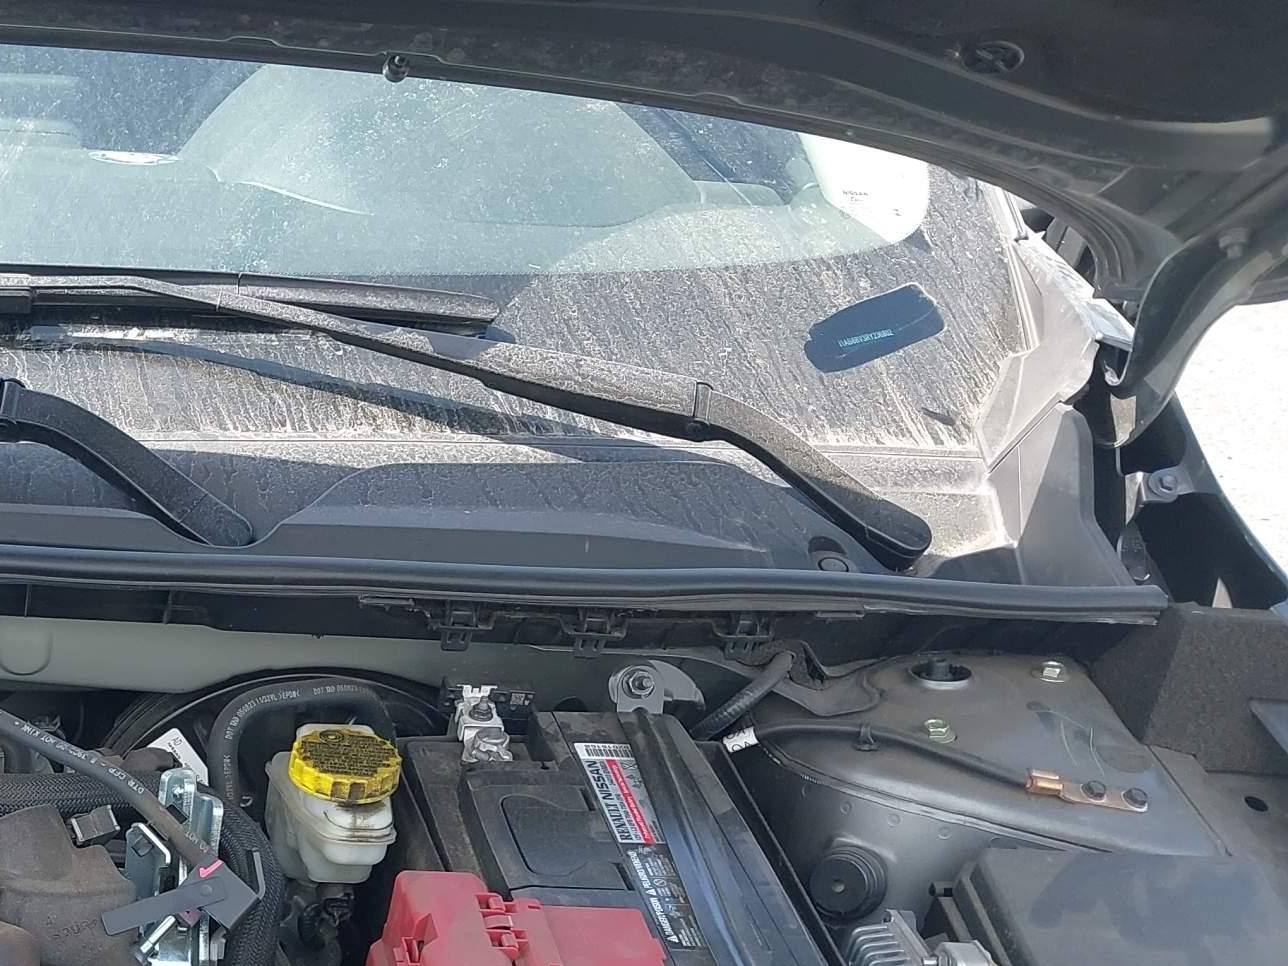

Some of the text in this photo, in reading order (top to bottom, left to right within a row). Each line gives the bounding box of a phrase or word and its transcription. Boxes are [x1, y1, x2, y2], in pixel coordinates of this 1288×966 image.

[20, 723, 40, 737] KINK
[106, 764, 127, 781] CFP
[584, 760, 615, 801] NISSAN
[125, 778, 145, 794] DTR
[604, 802, 633, 841] RENAULT
